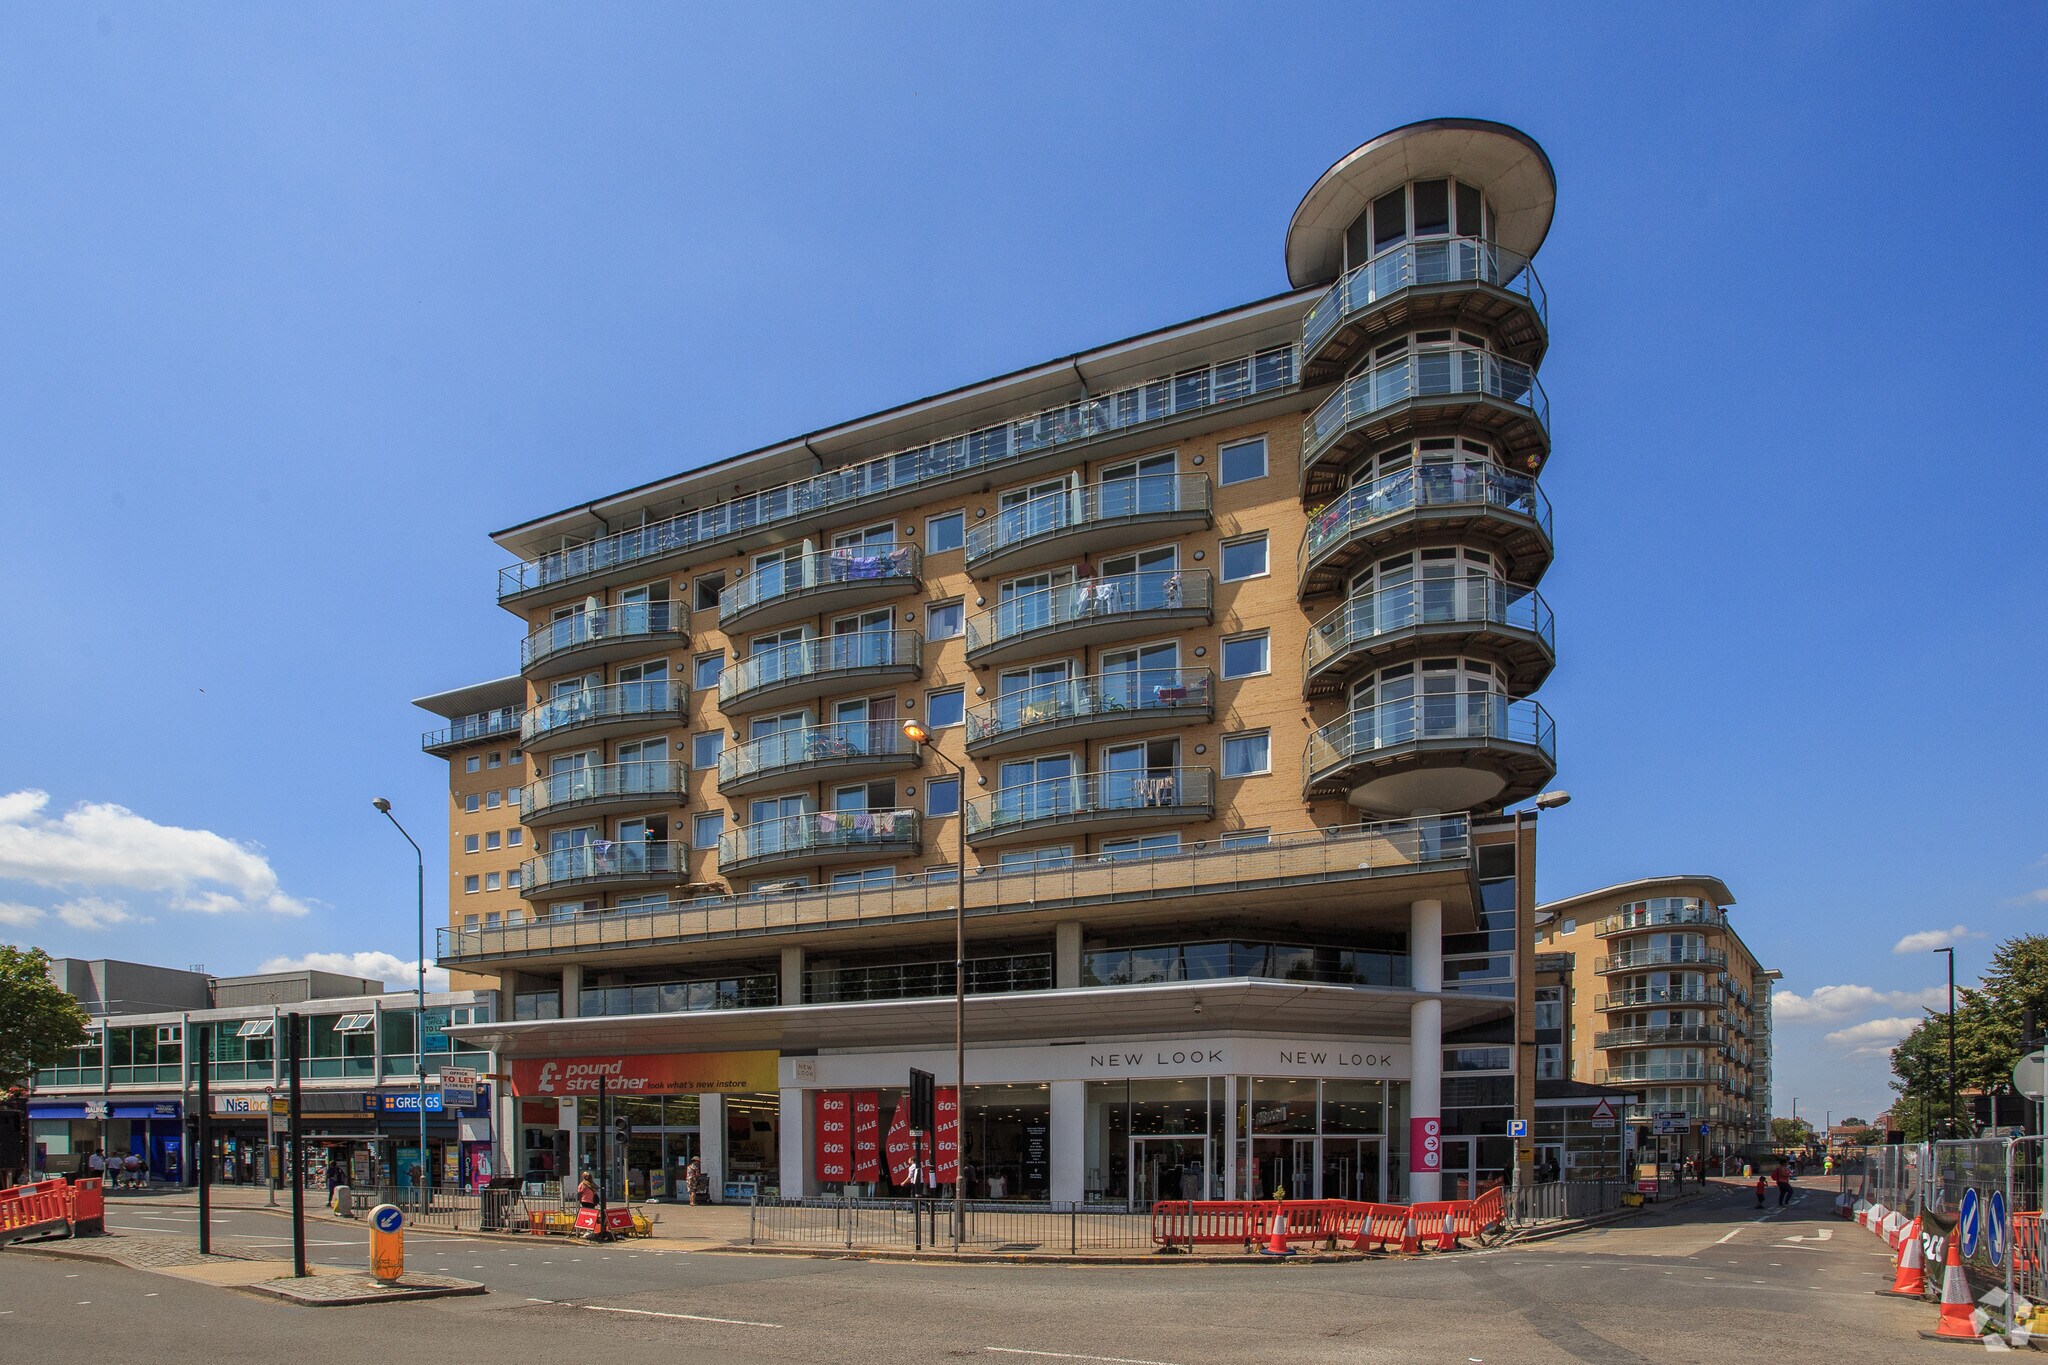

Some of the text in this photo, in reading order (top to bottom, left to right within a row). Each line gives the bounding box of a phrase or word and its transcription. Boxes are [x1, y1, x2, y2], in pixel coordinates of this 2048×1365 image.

[1090, 1050, 1223, 1068] NEW LOOK
[1280, 1051, 1392, 1067] NEW LOOK
[566, 1060, 622, 1079] pound
[442, 1075, 475, 1084] TO LET
[647, 1081, 666, 1090] look
[667, 1080, 694, 1090] what's
[695, 1081, 714, 1089] new
[716, 1079, 748, 1089] instore
[225, 1097, 269, 1112] Nisaloc
[396, 1097, 440, 1109] GREGS
[823, 1101, 844, 1110] 60%
[857, 1103, 875, 1112] 60%
[937, 1102, 957, 1111] 60%
[85, 1106, 108, 1114] HALIFAX
[823, 1122, 844, 1132] 60%
[857, 1120, 877, 1133] SALE
[937, 1119, 958, 1133] SALE
[1511, 1121, 1523, 1136] P
[823, 1144, 844, 1153] 60%
[888, 1142, 909, 1153] 60%
[938, 1142, 957, 1151] 60%
[823, 1165, 844, 1175] 60%
[857, 1158, 877, 1171] SALE
[892, 1161, 909, 1174] SAL
[937, 1159, 959, 1171] SALE
